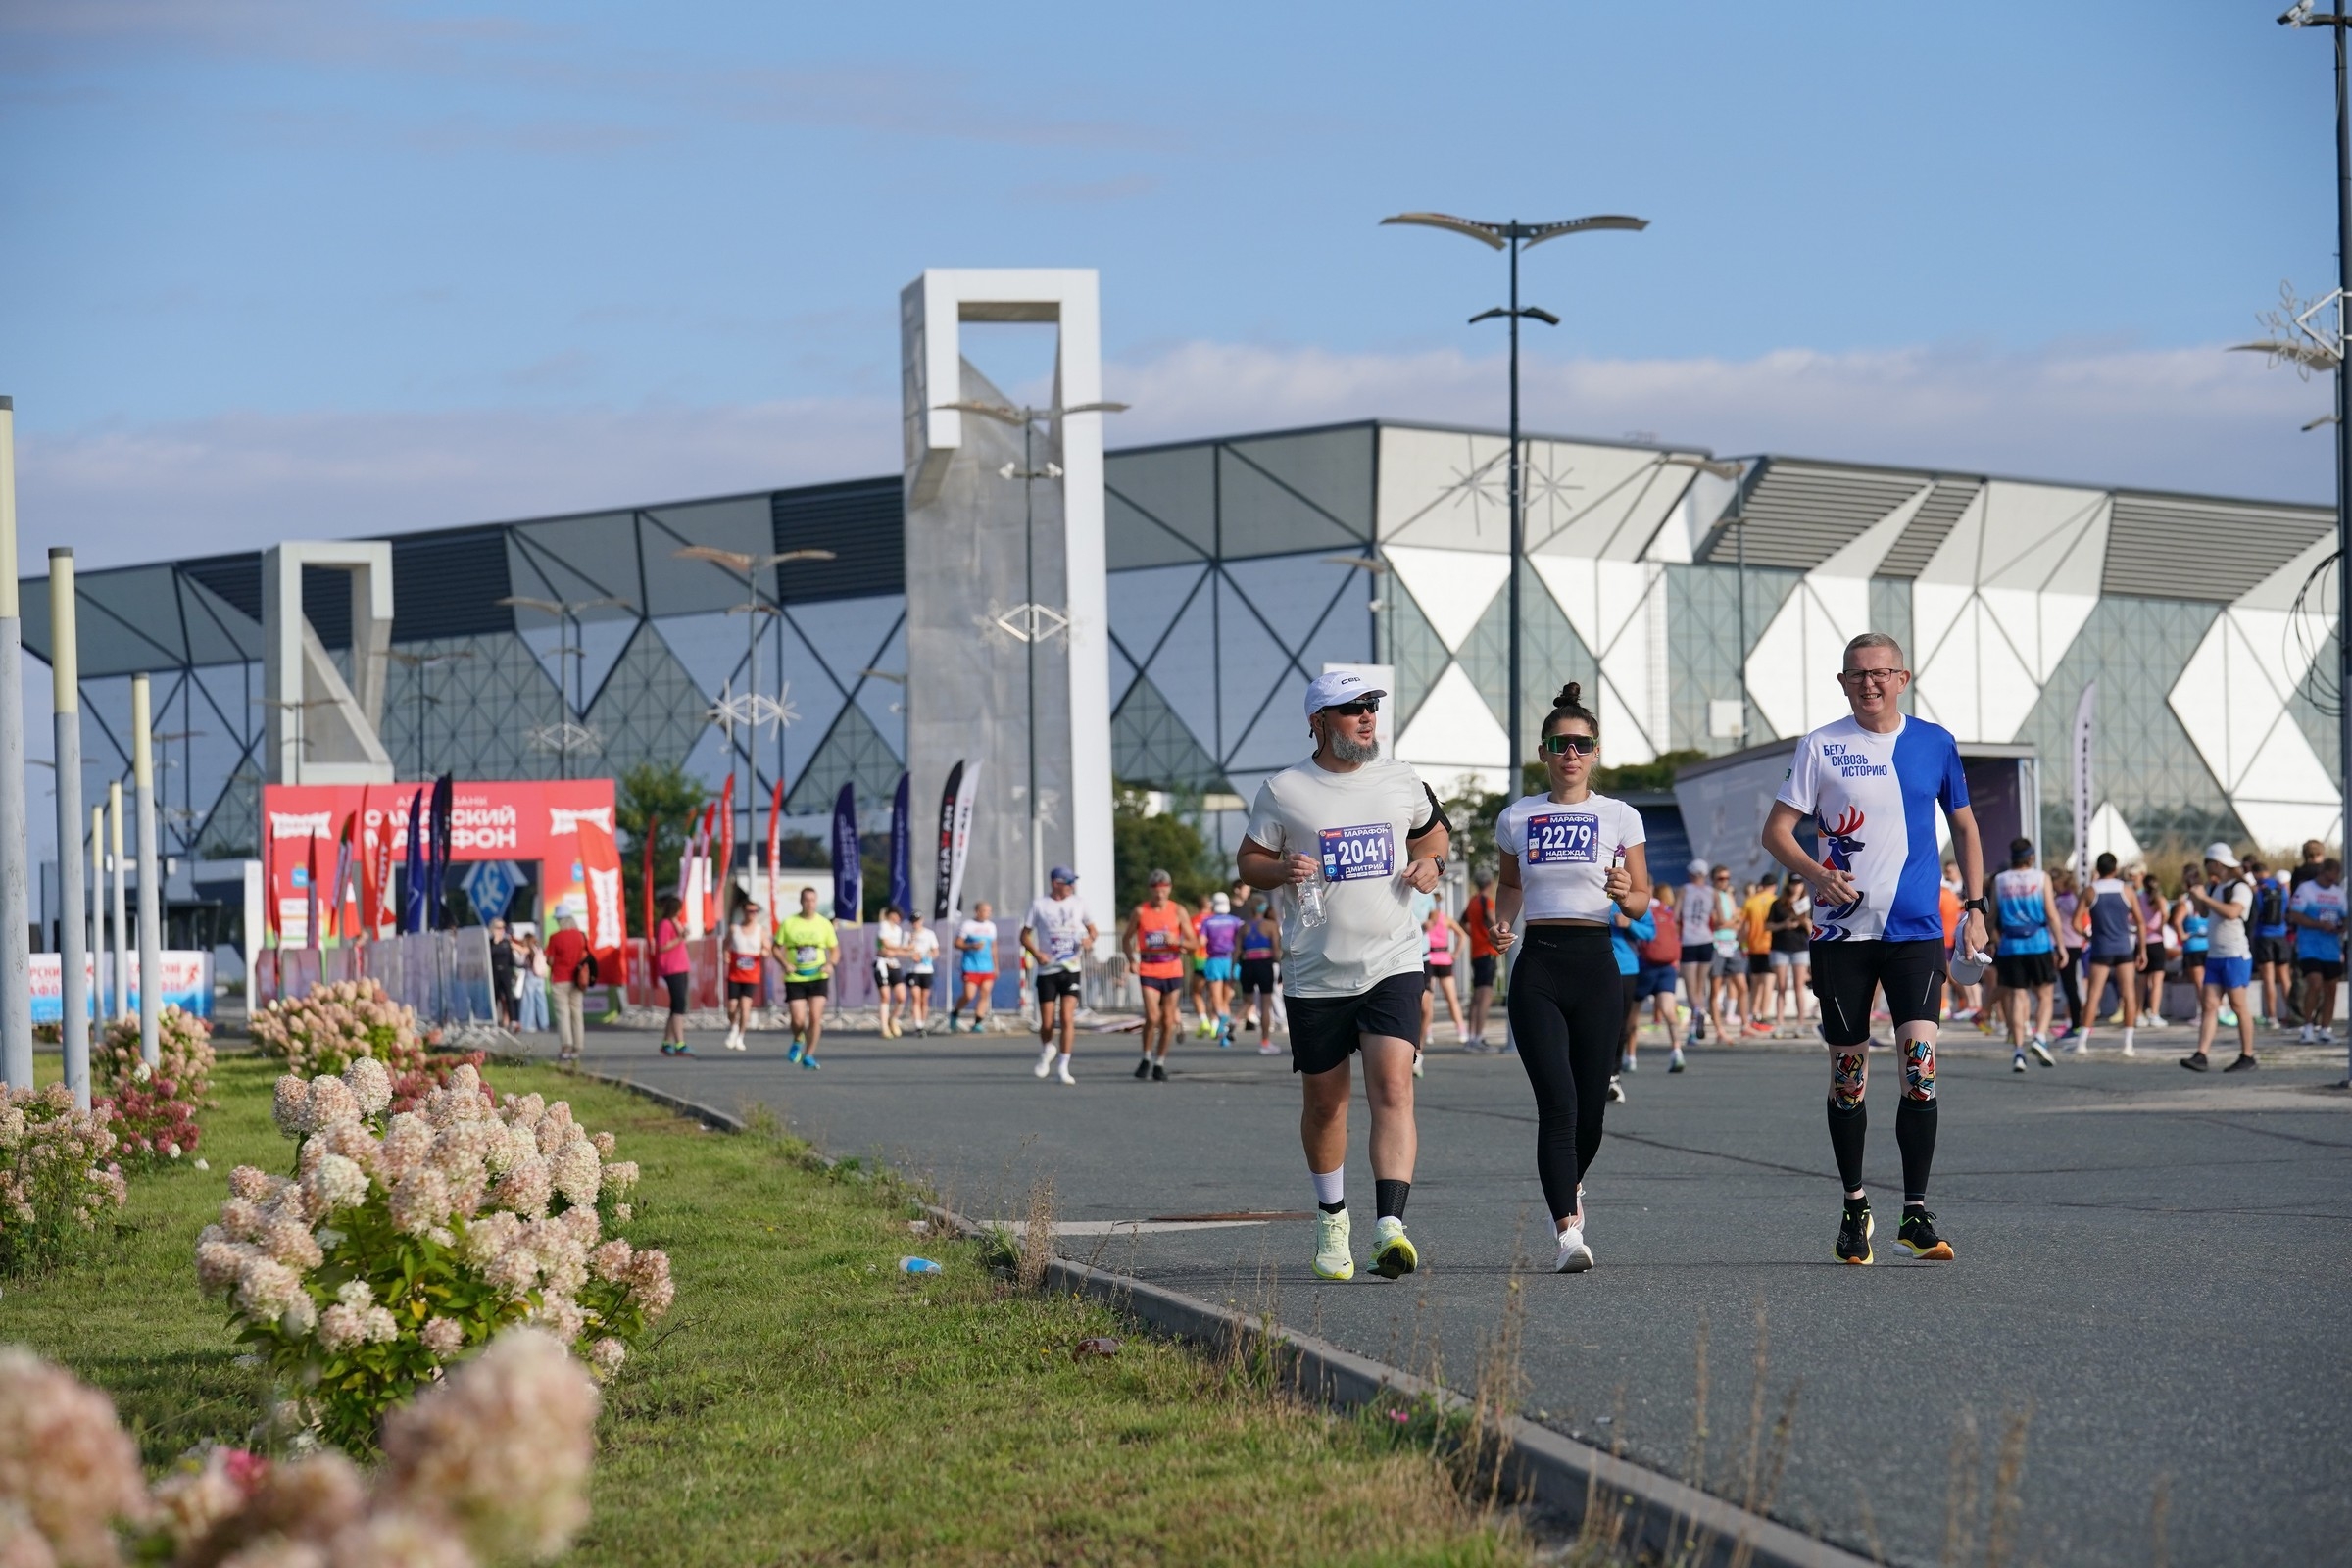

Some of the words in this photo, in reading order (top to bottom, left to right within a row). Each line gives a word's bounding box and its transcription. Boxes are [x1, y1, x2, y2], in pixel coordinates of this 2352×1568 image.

[1823, 744, 1847, 756] БЕГУ
[1832, 754, 1869, 766] СКВОЗЬ
[1841, 764, 1888, 777] ИСТОРИЮ
[1344, 827, 1389, 838] МАРАФОН
[1542, 825, 1592, 850] 2279
[1338, 837, 1388, 866] 2041
[1345, 861, 1385, 874] ДМИТРИЙ
